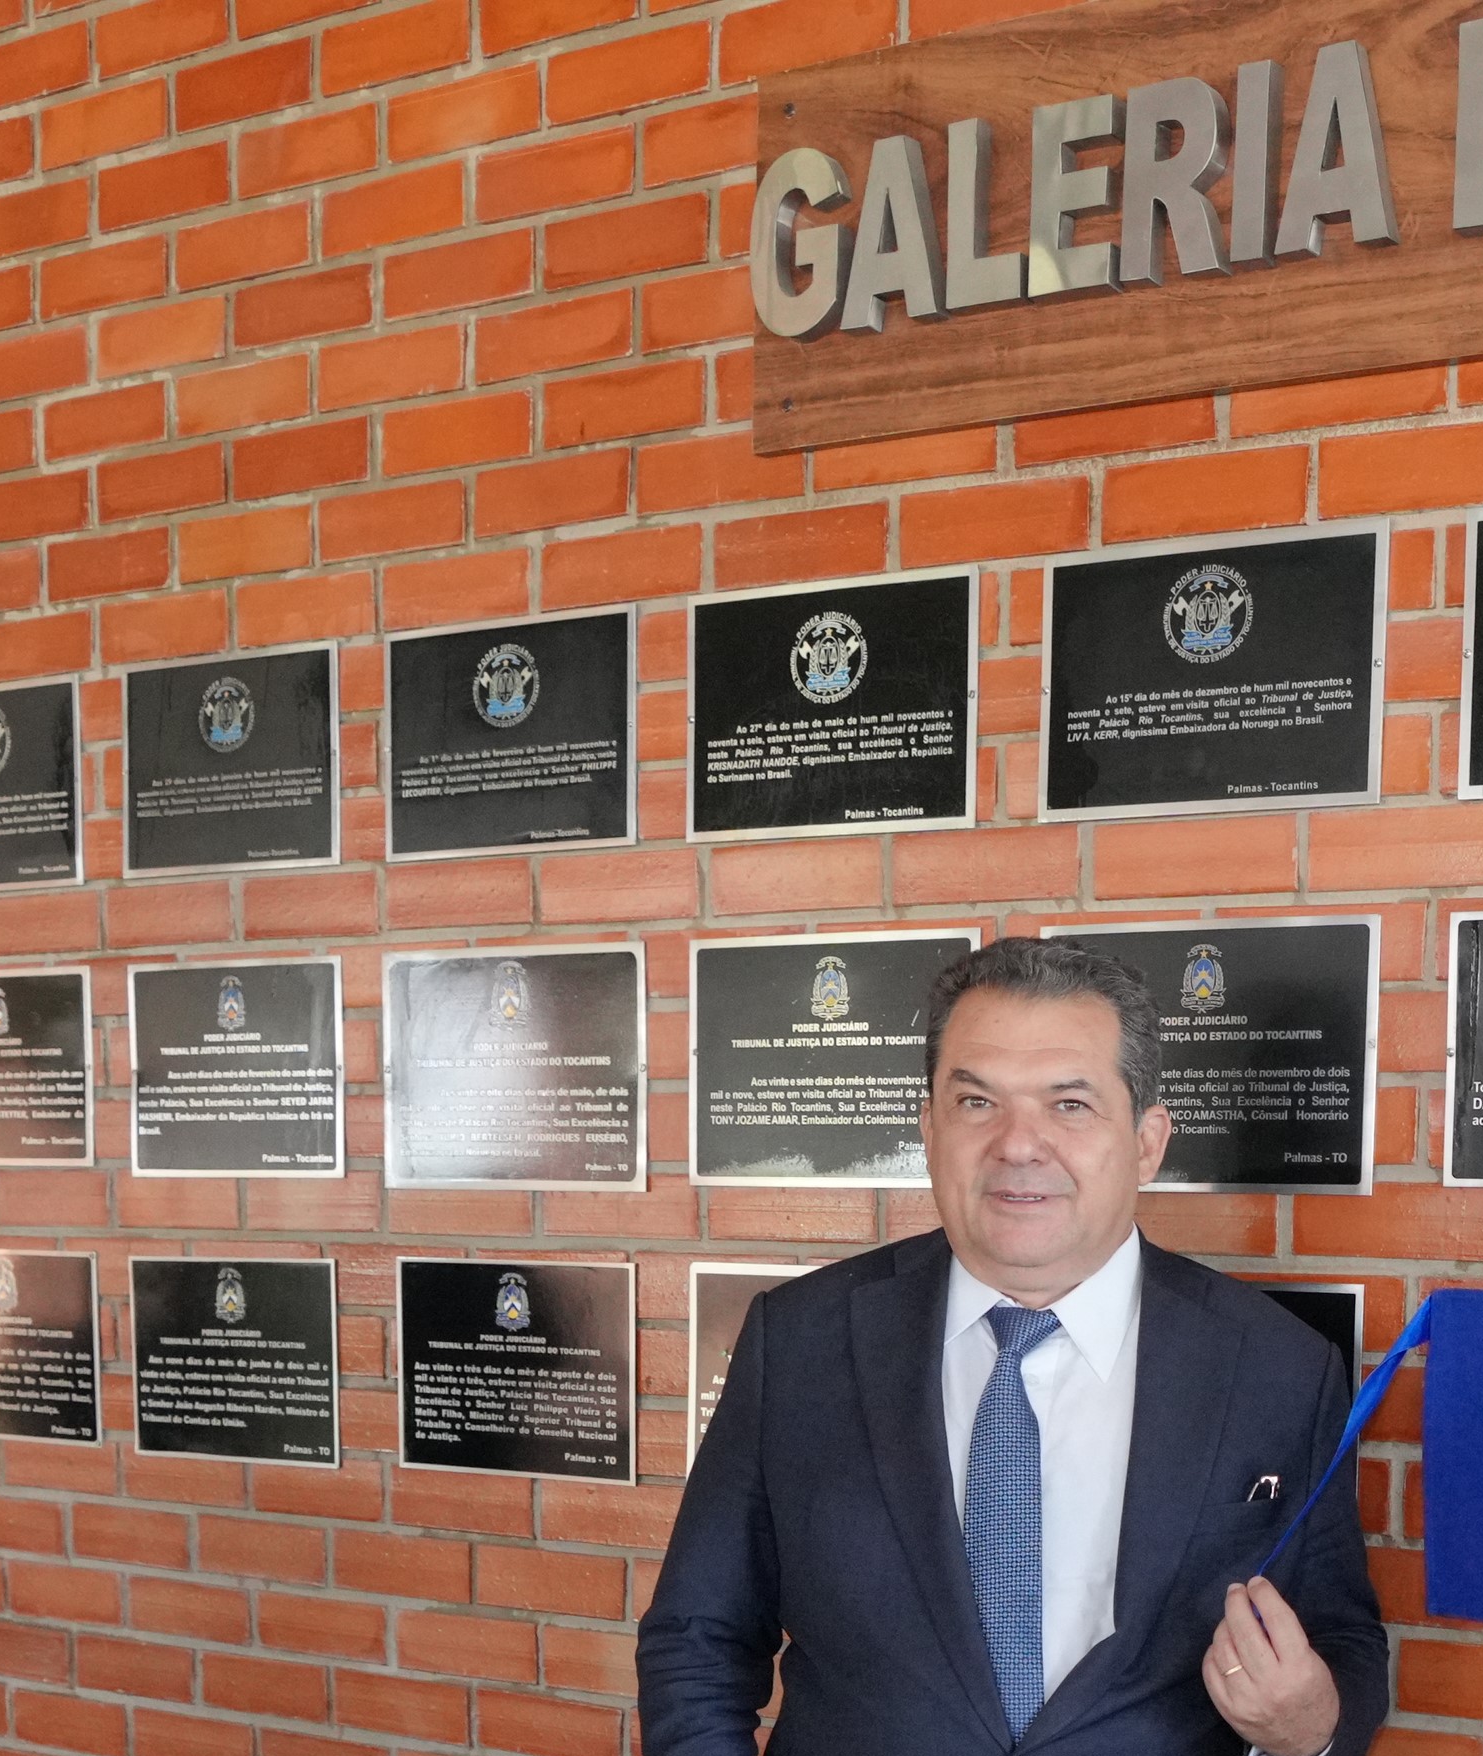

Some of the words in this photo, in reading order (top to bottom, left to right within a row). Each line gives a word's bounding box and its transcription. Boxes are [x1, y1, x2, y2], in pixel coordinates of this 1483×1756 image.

[751, 40, 1399, 341] GALERIA
[1067, 732, 1082, 742] LIV
[1082, 731, 1091, 741] A.
[1093, 729, 1120, 740] KERR,
[1170, 722, 1226, 734] Embaixadora
[1228, 721, 1239, 730] da
[1242, 719, 1278, 729] Noruega
[1281, 718, 1293, 726] no
[1295, 714, 1323, 725] Brasil.
[581, 760, 616, 771] PHILIPPE
[710, 1115, 735, 1125] TONY
[735, 1115, 771, 1125] JOZAME
[801, 1114, 852, 1125] Embaixador
[853, 1114, 864, 1125] da
[864, 1113, 906, 1125] Colômbia
[907, 1117, 918, 1125] no
[1169, 1110, 1192, 1121] NCO
[1192, 1110, 1247, 1121] AMASTHA,
[1251, 1110, 1287, 1120] Cônsul
[1296, 1109, 1349, 1120] Honorário
[414, 1395, 460, 1407] Excelência
[475, 1399, 505, 1409] Senhor
[510, 1402, 527, 1410] Luiz
[533, 1403, 568, 1414] Philippe
[574, 1406, 599, 1415] Vieira
[605, 1408, 616, 1417] de
[283, 1443, 312, 1454] Palmas
[318, 1446, 330, 1455] TO
[564, 1452, 596, 1463] Palmas
[604, 1455, 616, 1465] TO
